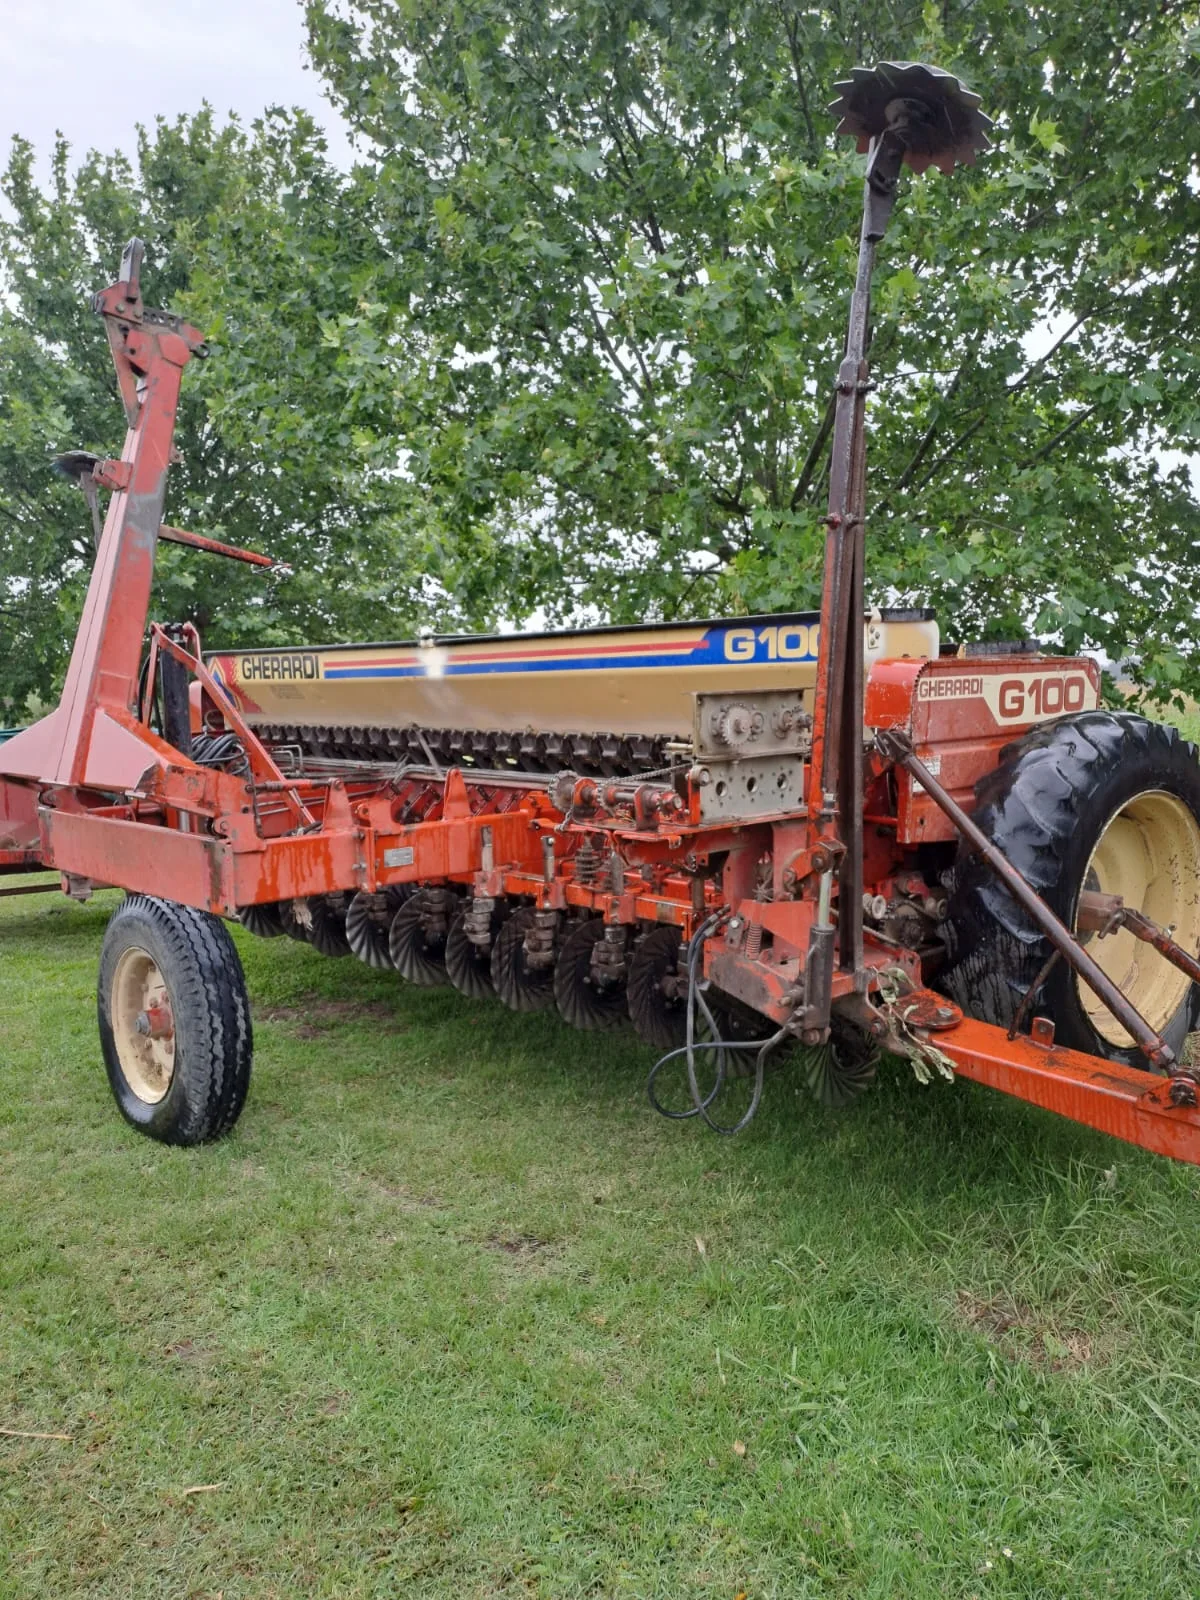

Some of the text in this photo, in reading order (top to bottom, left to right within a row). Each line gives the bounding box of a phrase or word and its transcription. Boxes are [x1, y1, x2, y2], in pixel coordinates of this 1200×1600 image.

[242, 655, 320, 680] GHERARDI
[919, 677, 1085, 718] GHERARDI G100
